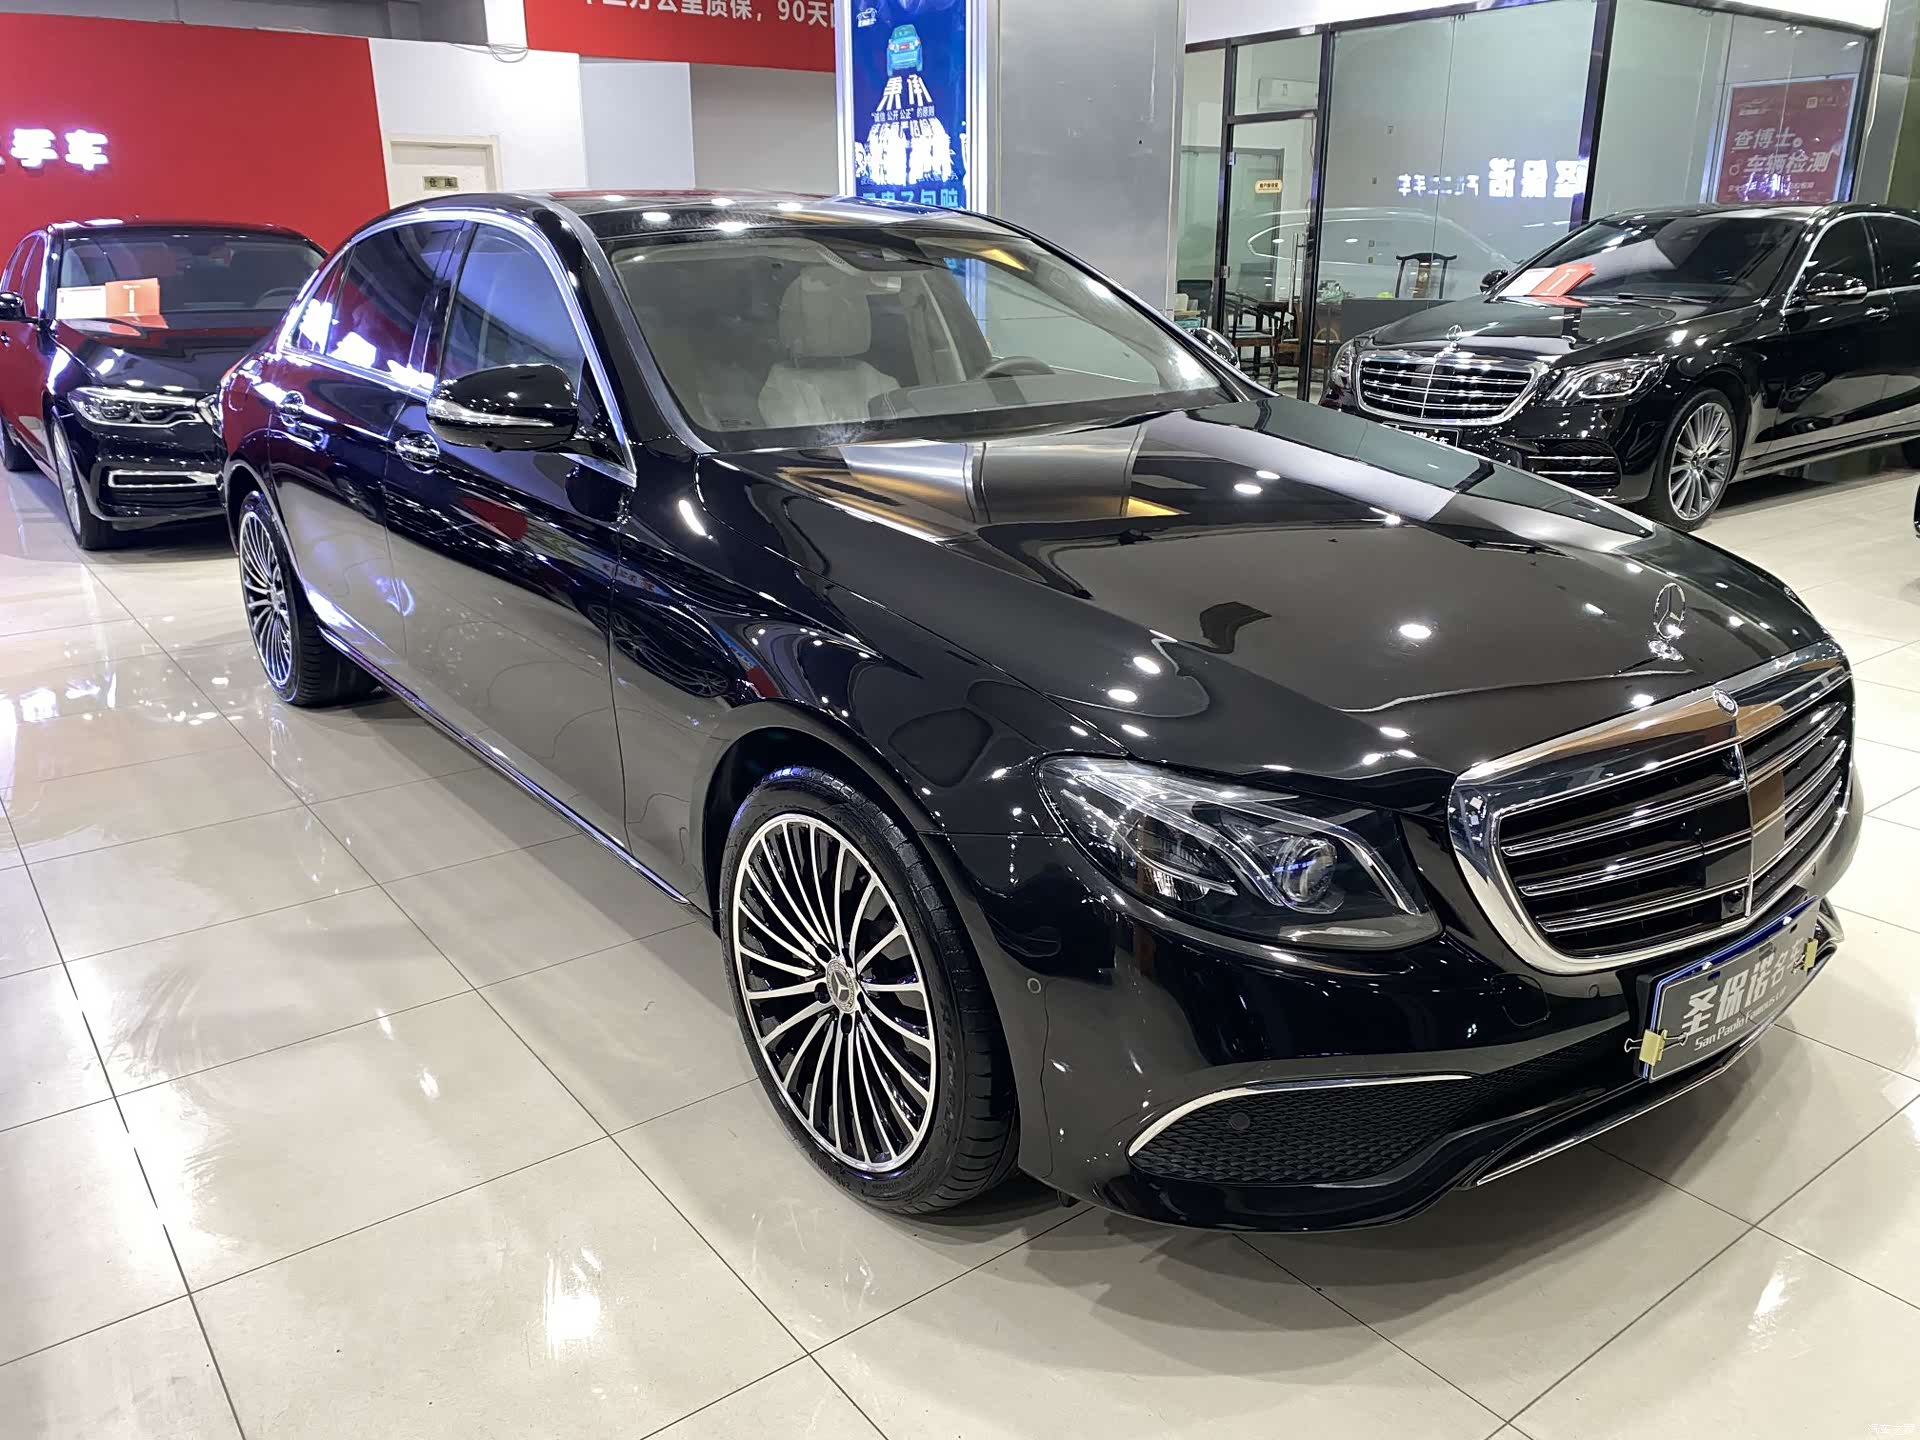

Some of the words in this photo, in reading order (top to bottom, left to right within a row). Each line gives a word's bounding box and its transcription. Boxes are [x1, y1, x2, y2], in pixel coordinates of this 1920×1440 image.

[876, 74, 933, 112] 秉承
[0, 128, 109, 171] 手车
[1743, 150, 1832, 174] 车辆检测
[1694, 1033, 1717, 1051] San
[1717, 1016, 1745, 1040] Paolo
